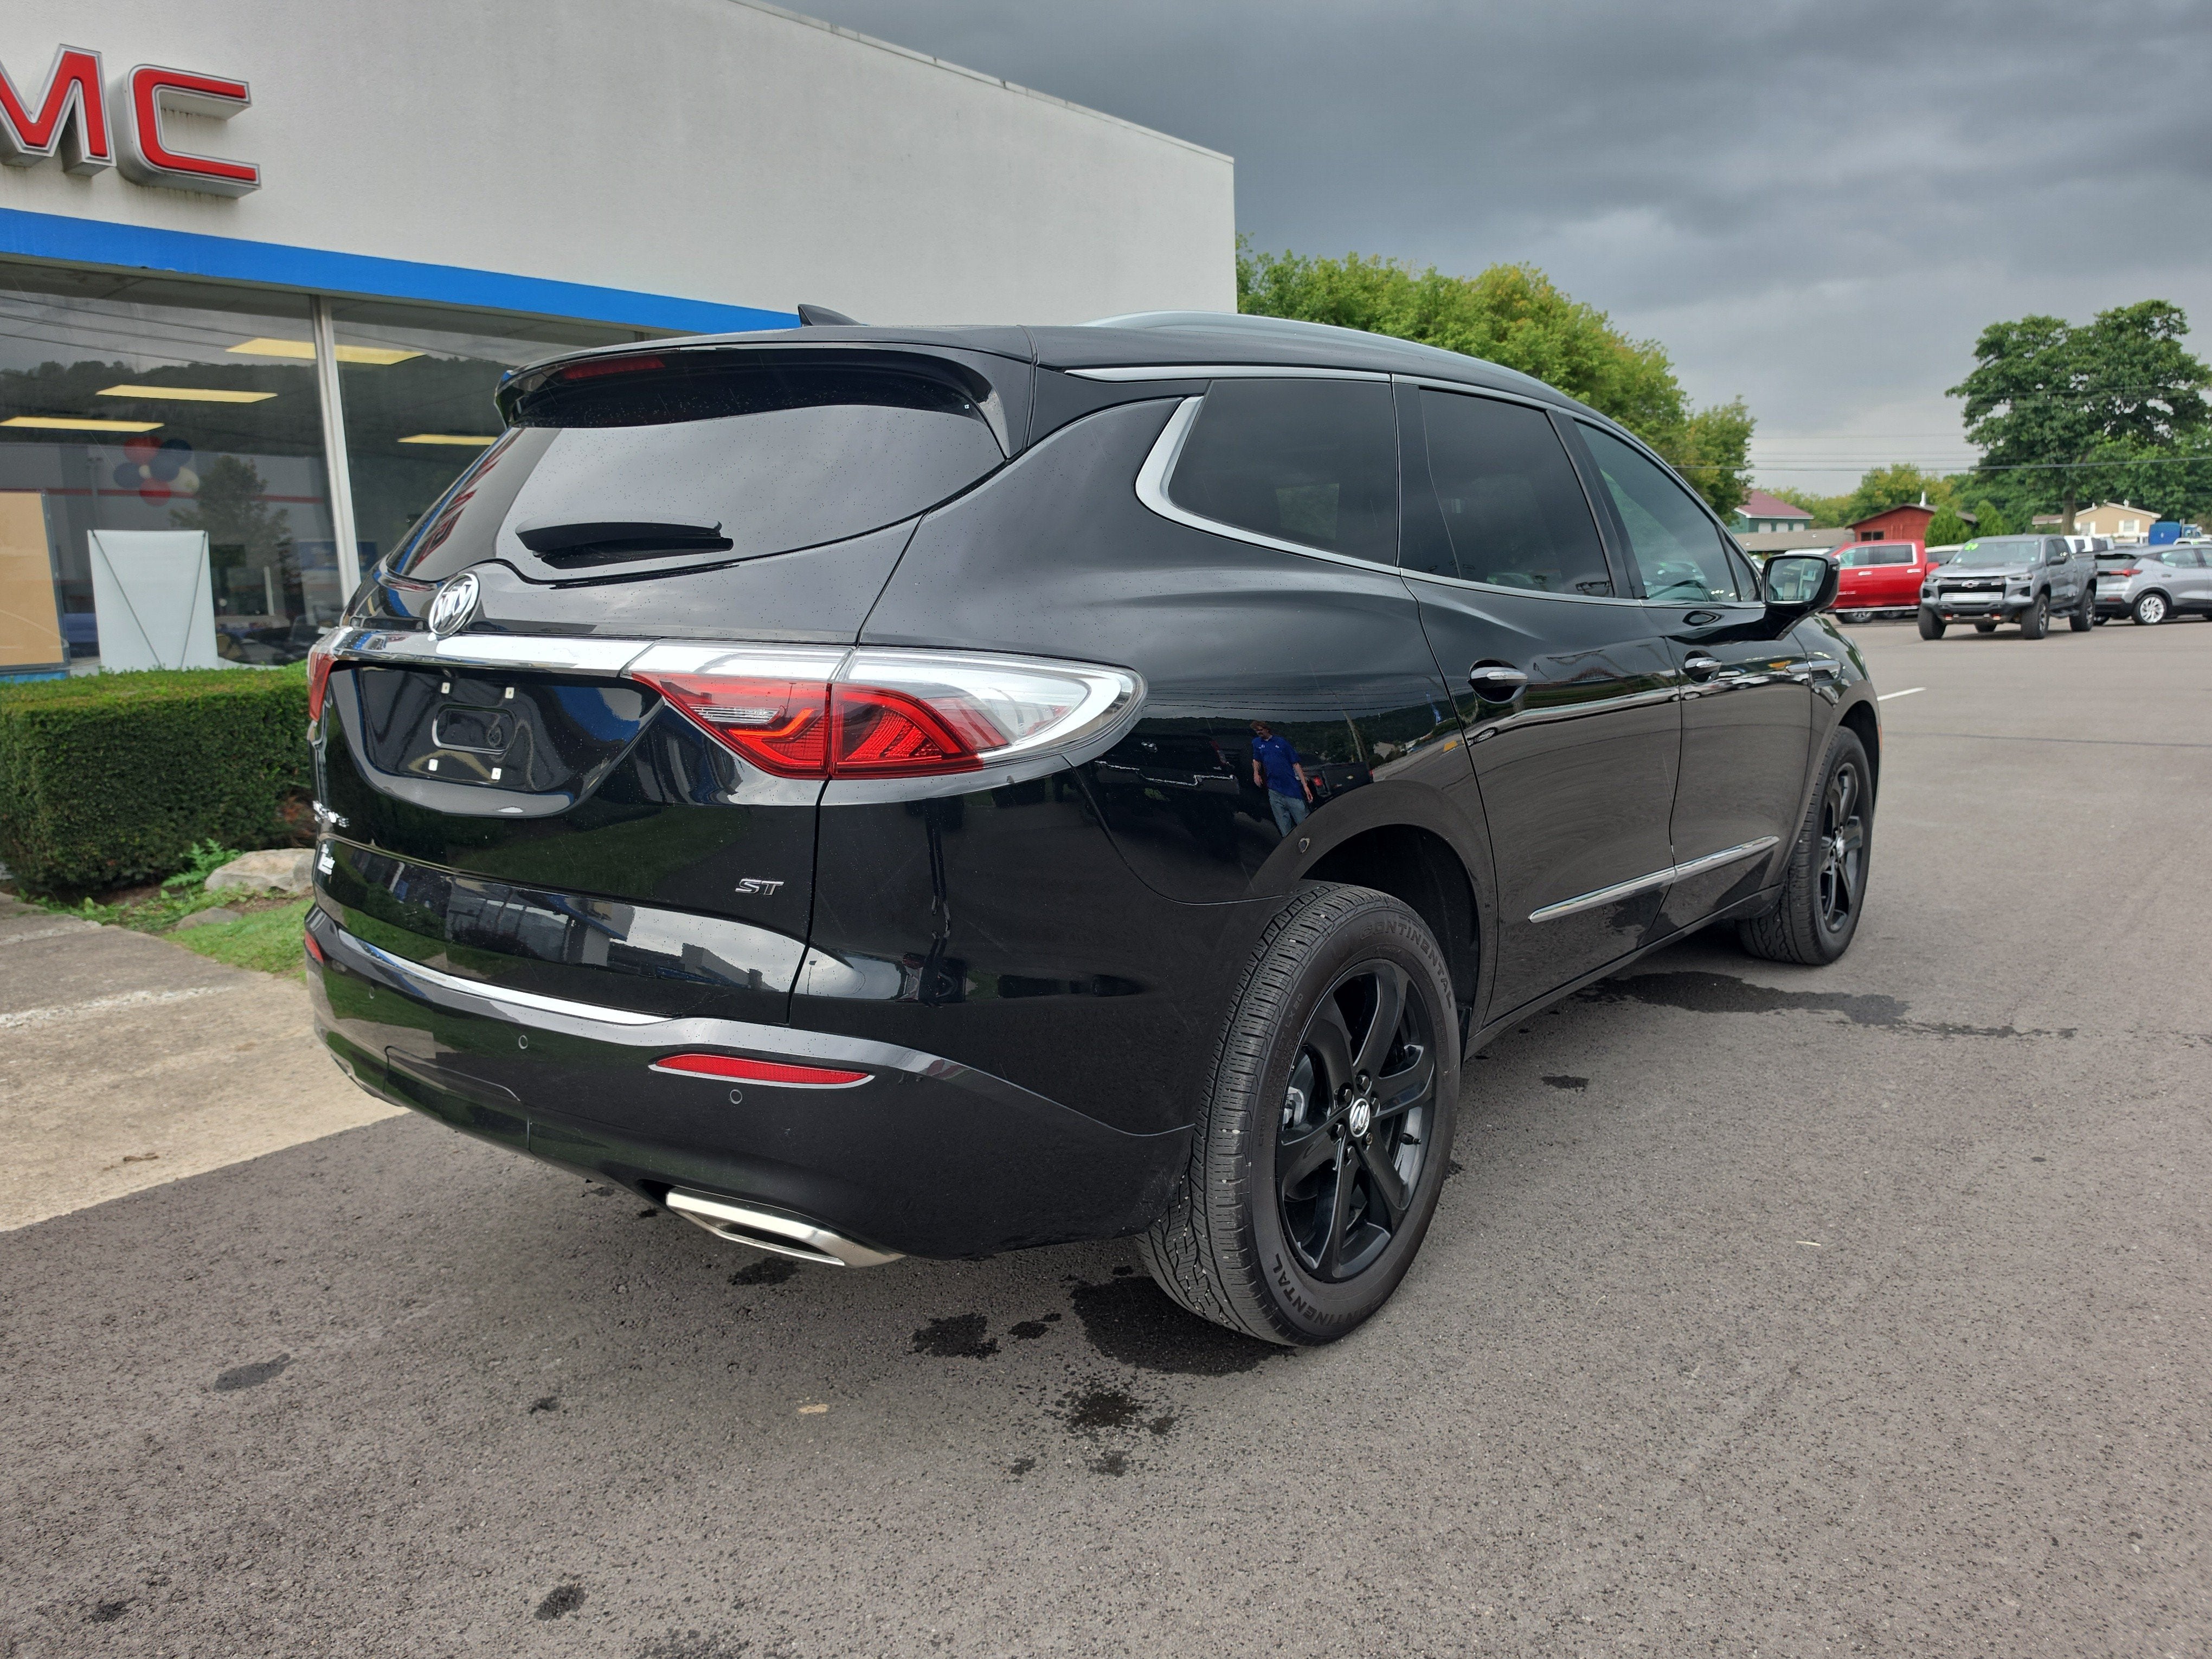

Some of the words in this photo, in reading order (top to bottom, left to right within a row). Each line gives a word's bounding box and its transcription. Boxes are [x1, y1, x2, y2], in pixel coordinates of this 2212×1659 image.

[735, 878, 785, 896] ST
[1360, 921, 1452, 1009] CONTINENTAL
[1285, 1011, 1295, 1028] LX
[1294, 993, 1304, 1009] 20
[1272, 1252, 1384, 1326] CONTINENTAL
